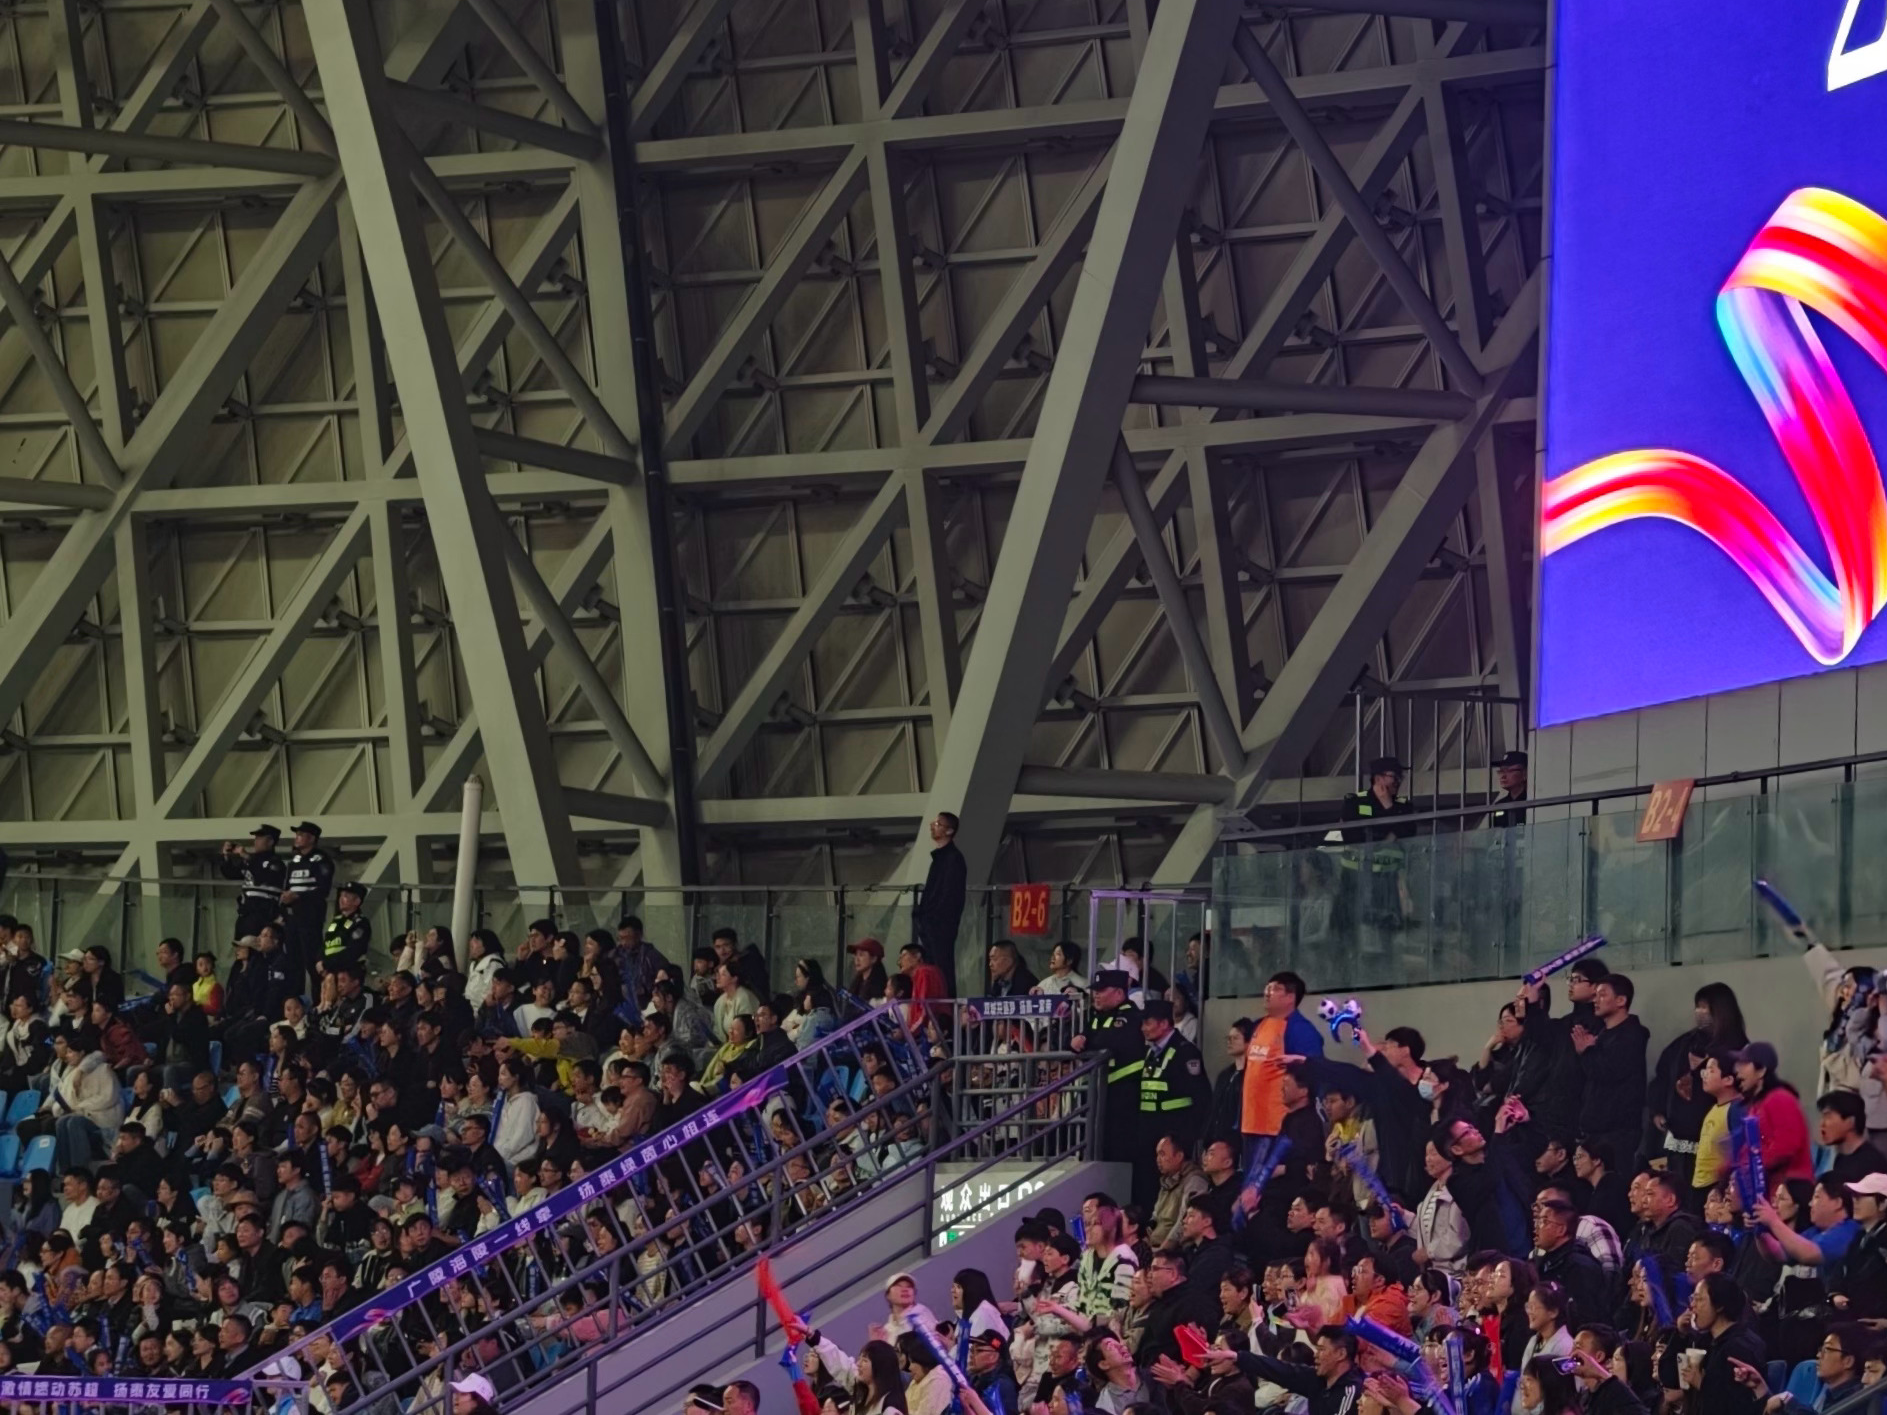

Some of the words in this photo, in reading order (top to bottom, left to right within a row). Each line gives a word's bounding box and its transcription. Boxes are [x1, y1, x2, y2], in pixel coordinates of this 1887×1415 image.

[1641, 786, 1689, 834] B2-4
[1012, 890, 1046, 928] B2-6
[406, 1205, 553, 1299] 广陵海陵一线牵
[577, 1108, 721, 1200] 扬泰绿茵心相连
